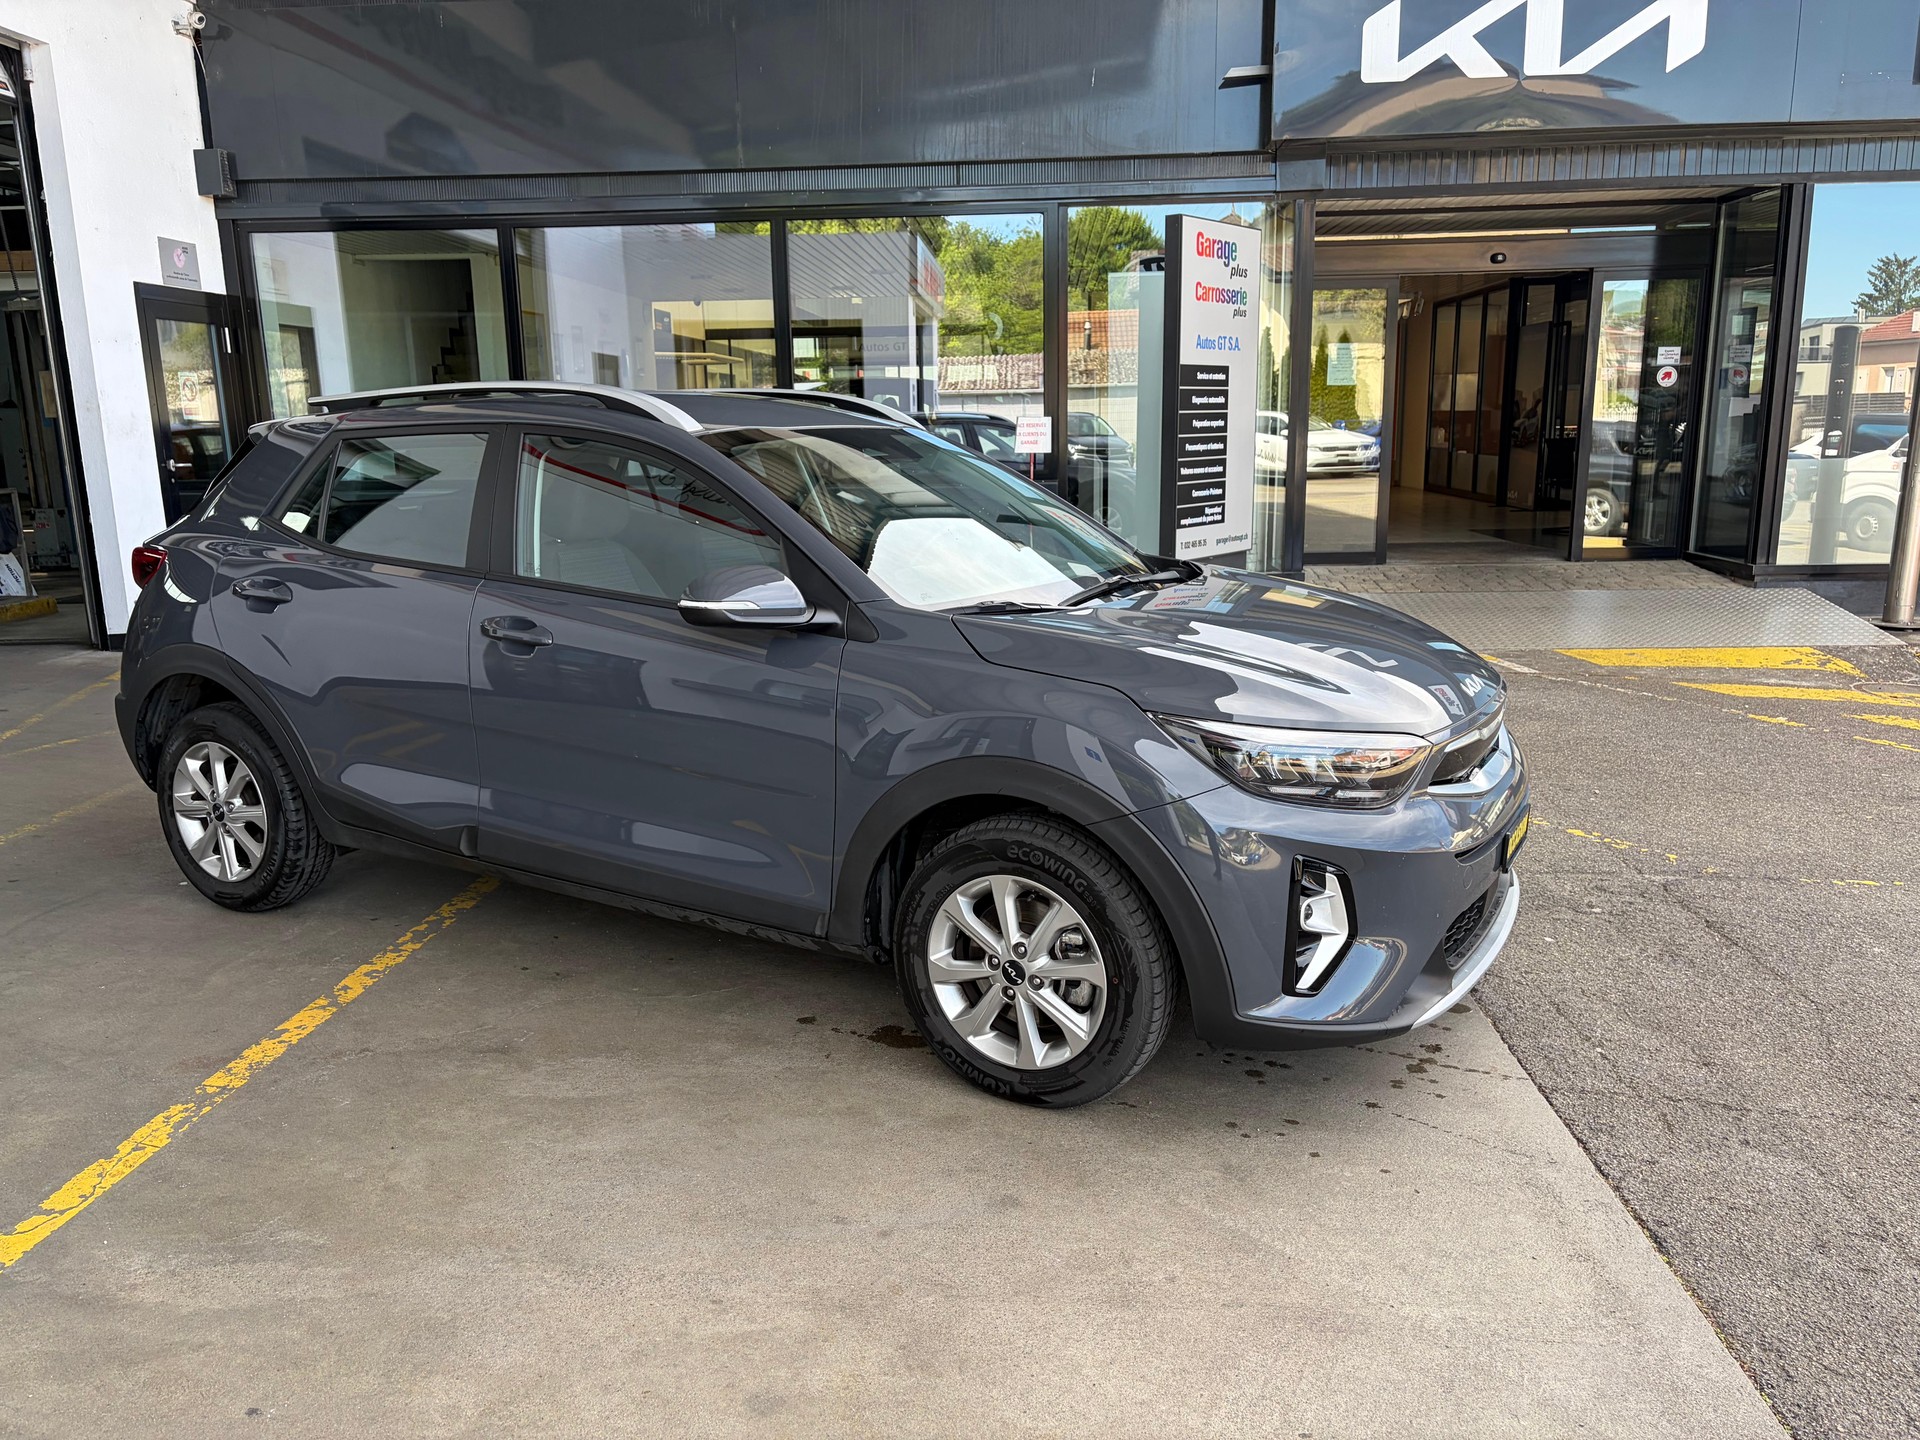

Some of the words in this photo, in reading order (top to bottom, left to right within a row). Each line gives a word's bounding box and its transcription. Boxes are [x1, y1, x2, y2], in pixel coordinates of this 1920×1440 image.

[1196, 231, 1237, 268] Garage
[1230, 264, 1248, 279] plus
[1195, 281, 1248, 306] Carrosserie
[1233, 306, 1247, 319] plus
[859, 342, 889, 352] Autos
[893, 342, 907, 351] GT
[1196, 334, 1216, 350] Autos
[1217, 336, 1228, 351] GT
[942, 1047, 1011, 1097] KUMHO
